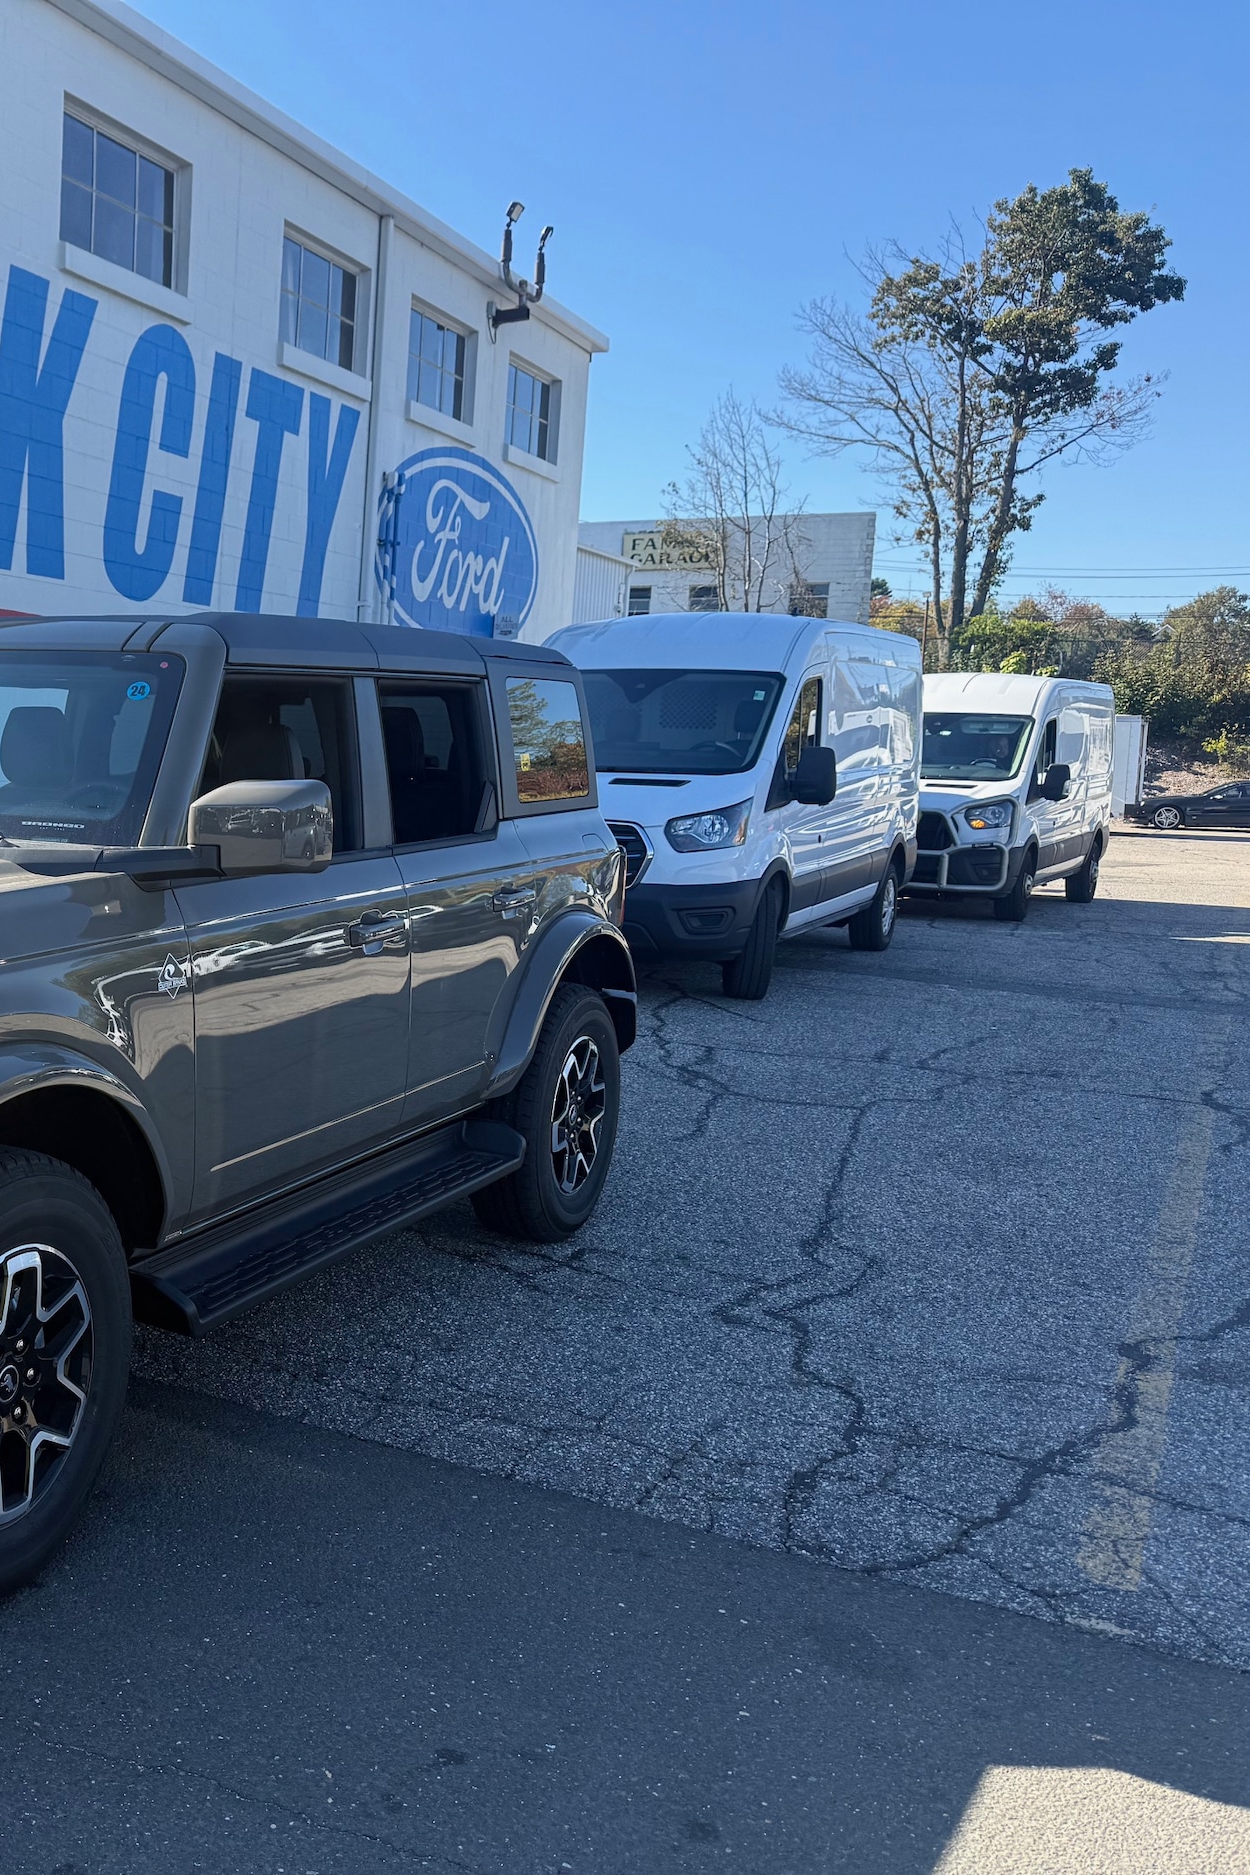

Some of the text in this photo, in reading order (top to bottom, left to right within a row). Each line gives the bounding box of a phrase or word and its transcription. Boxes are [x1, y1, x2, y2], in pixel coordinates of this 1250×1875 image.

[103, 323, 360, 617] CITY
[411, 479, 510, 616] Ford
[130, 685, 147, 697] 24
